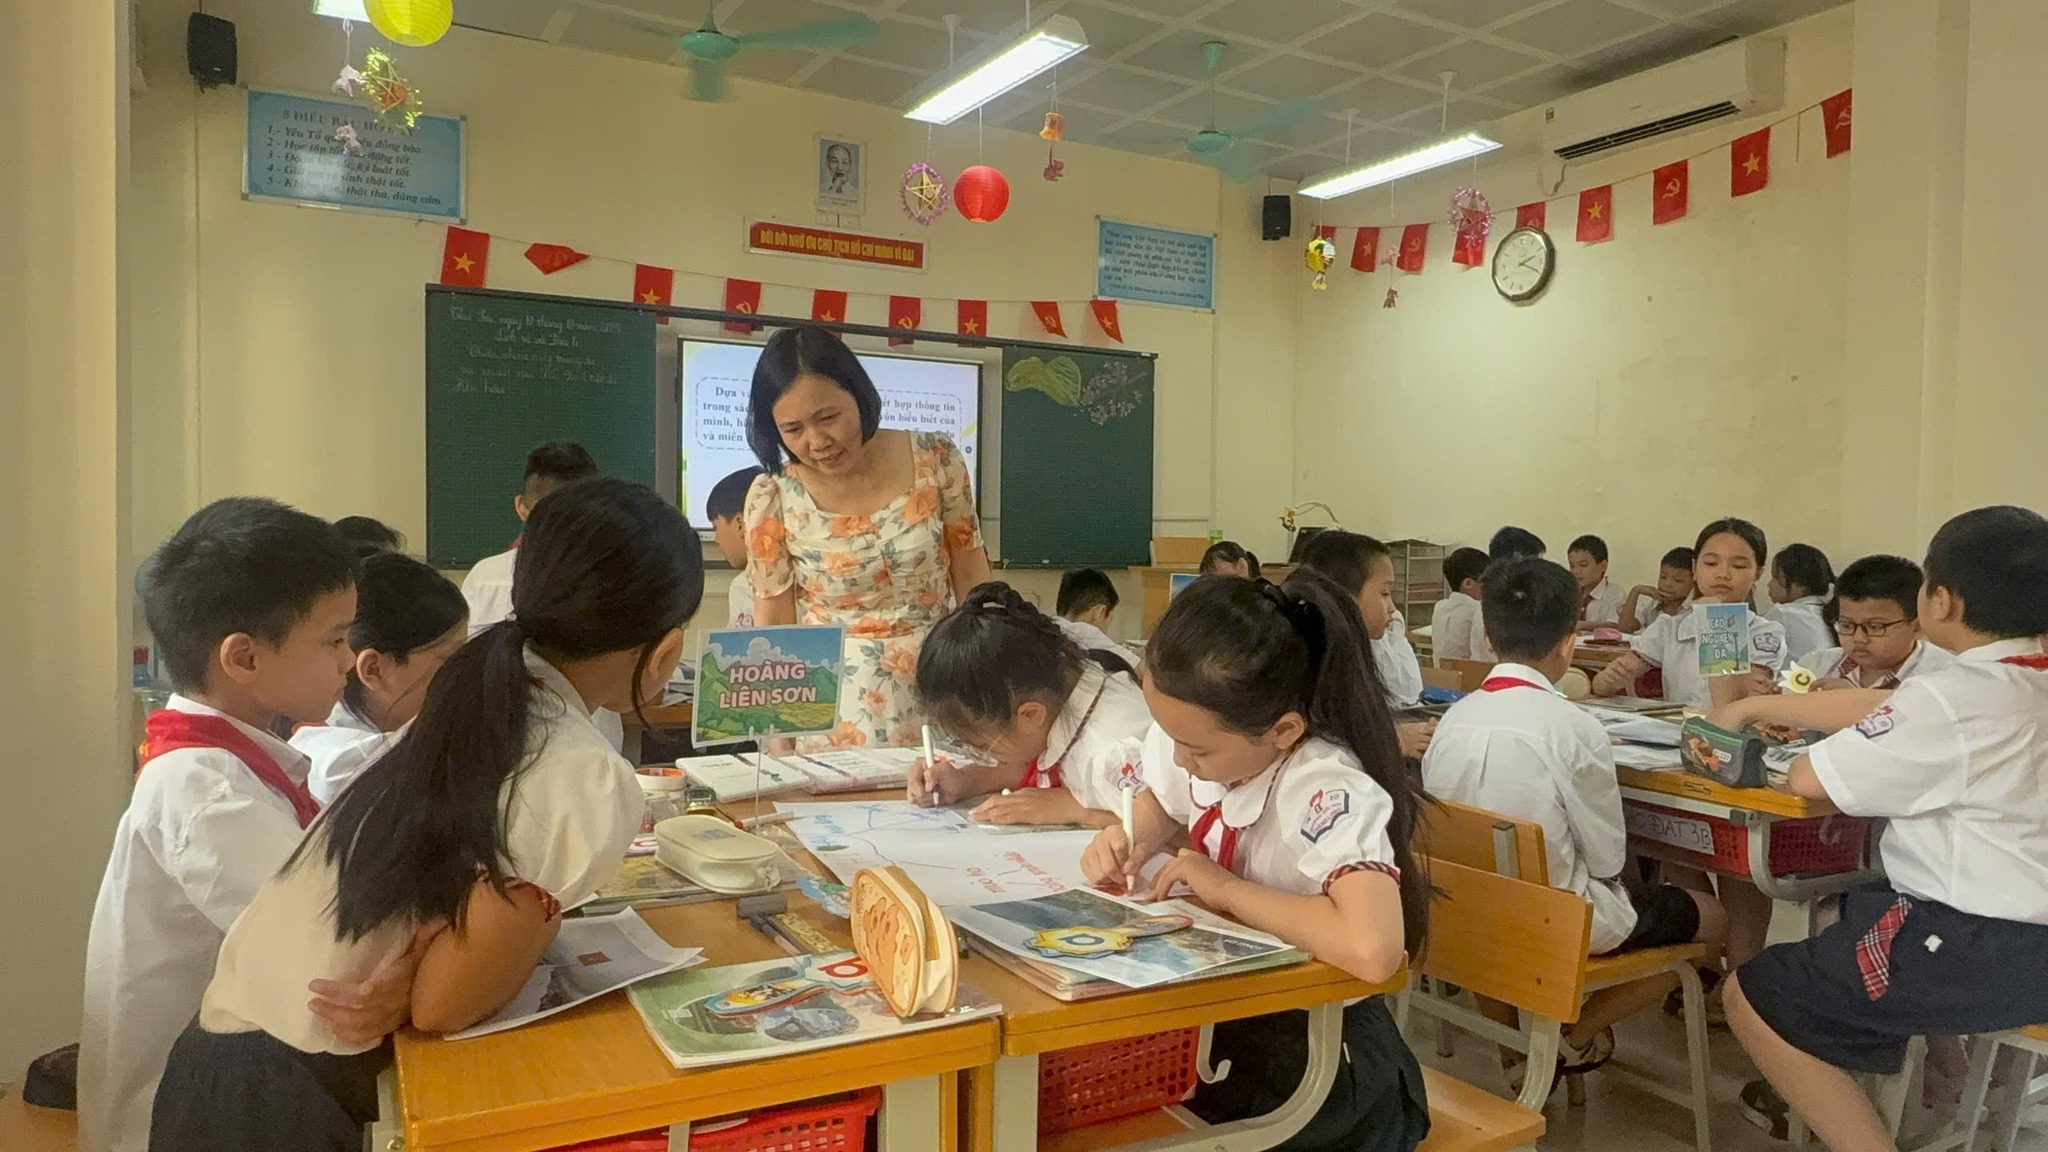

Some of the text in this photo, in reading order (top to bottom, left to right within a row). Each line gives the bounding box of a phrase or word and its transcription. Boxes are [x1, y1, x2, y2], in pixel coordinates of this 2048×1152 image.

[284, 126, 304, 138] Yêu
[715, 386, 737, 399] Dựa
[703, 402, 731, 414] trong
[894, 399, 912, 411] hợp
[915, 400, 941, 412] thông
[943, 403, 956, 412] tin
[703, 416, 733, 428] mình,
[898, 411, 918, 423] hiểu
[920, 412, 937, 424] biết
[939, 414, 956, 425] của
[702, 429, 743, 442] và miền
[729, 659, 806, 684] HOÀNG
[719, 686, 817, 709] LIÊN SƠN
